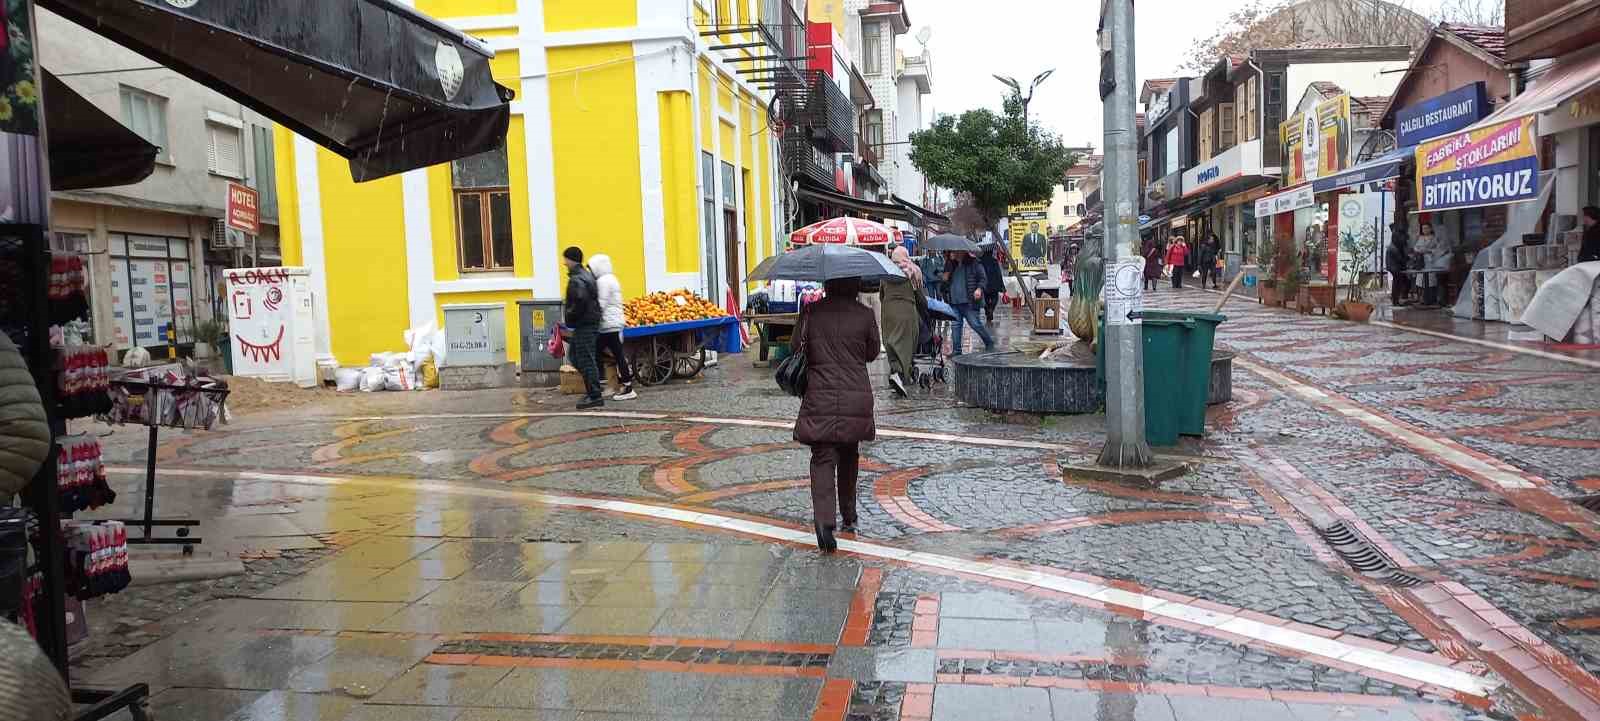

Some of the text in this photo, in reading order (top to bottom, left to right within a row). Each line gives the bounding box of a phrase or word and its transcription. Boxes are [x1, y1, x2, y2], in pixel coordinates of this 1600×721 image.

[1400, 99, 1473, 137] ÇALGILI RESTAURANT
[1426, 133, 1472, 168] FABRİKA
[1456, 126, 1521, 171] STOKLARINI
[231, 186, 256, 209] HOTEL
[1425, 168, 1532, 206] BİTİRİYORUZ
[229, 268, 290, 286] ROACH
